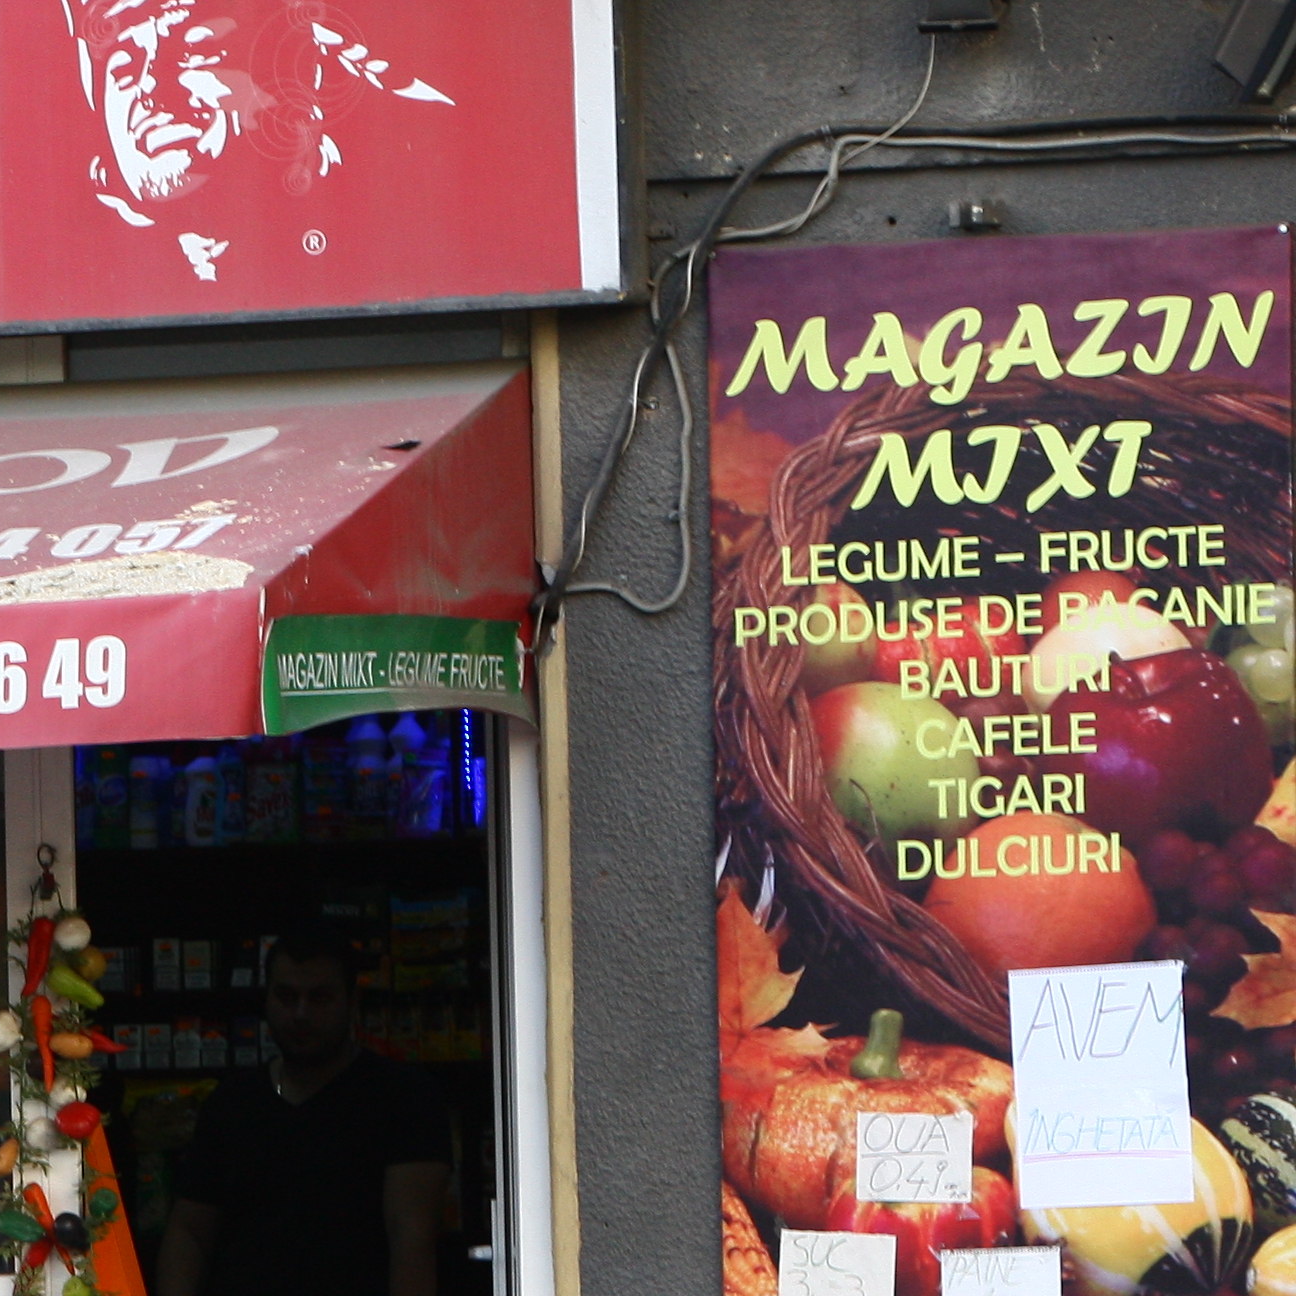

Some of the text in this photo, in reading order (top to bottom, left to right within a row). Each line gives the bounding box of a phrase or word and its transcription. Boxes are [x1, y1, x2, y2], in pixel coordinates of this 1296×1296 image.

[725, 290, 1274, 405] MAGAZIN
[851, 421, 1153, 512] MIXT
[50, 513, 238, 558] 057
[781, 524, 1226, 586] LEGUME FRUCTE
[734, 582, 1277, 647] PRODUSE DE BACANIE
[42, 634, 127, 709] 49
[277, 651, 507, 690] MAGAZIN MIXT LEGUME FRUCTE
[899, 653, 1111, 699] BAUTURI
[914, 713, 1098, 760] CAFELE
[928, 773, 1087, 819] TIGARI
[897, 833, 1121, 879] DULCIURI
[1017, 977, 1183, 1068] AVEM
[791, 1234, 851, 1273] SUC
